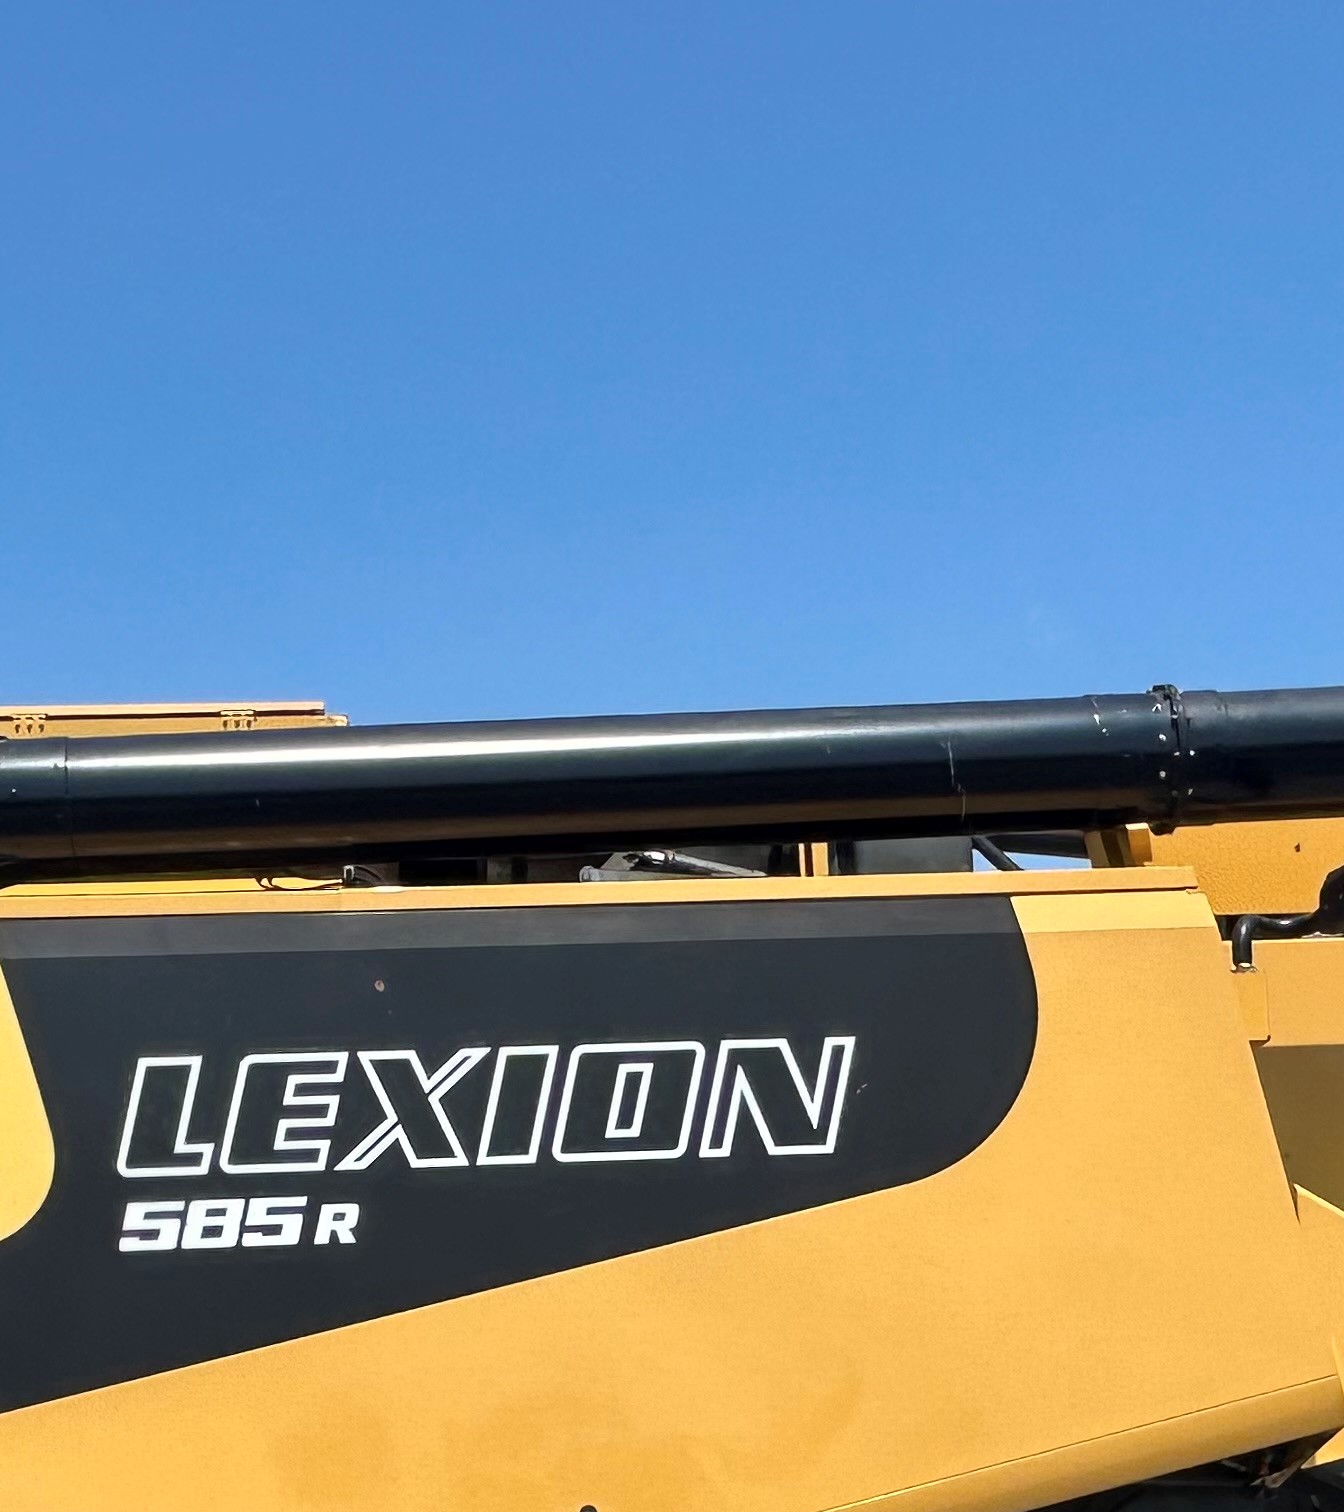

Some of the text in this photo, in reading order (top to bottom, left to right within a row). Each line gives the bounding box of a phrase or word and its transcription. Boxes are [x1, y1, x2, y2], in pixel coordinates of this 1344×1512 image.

[117, 1036, 856, 1177] LEXION
[119, 1196, 359, 1251] 585 R
